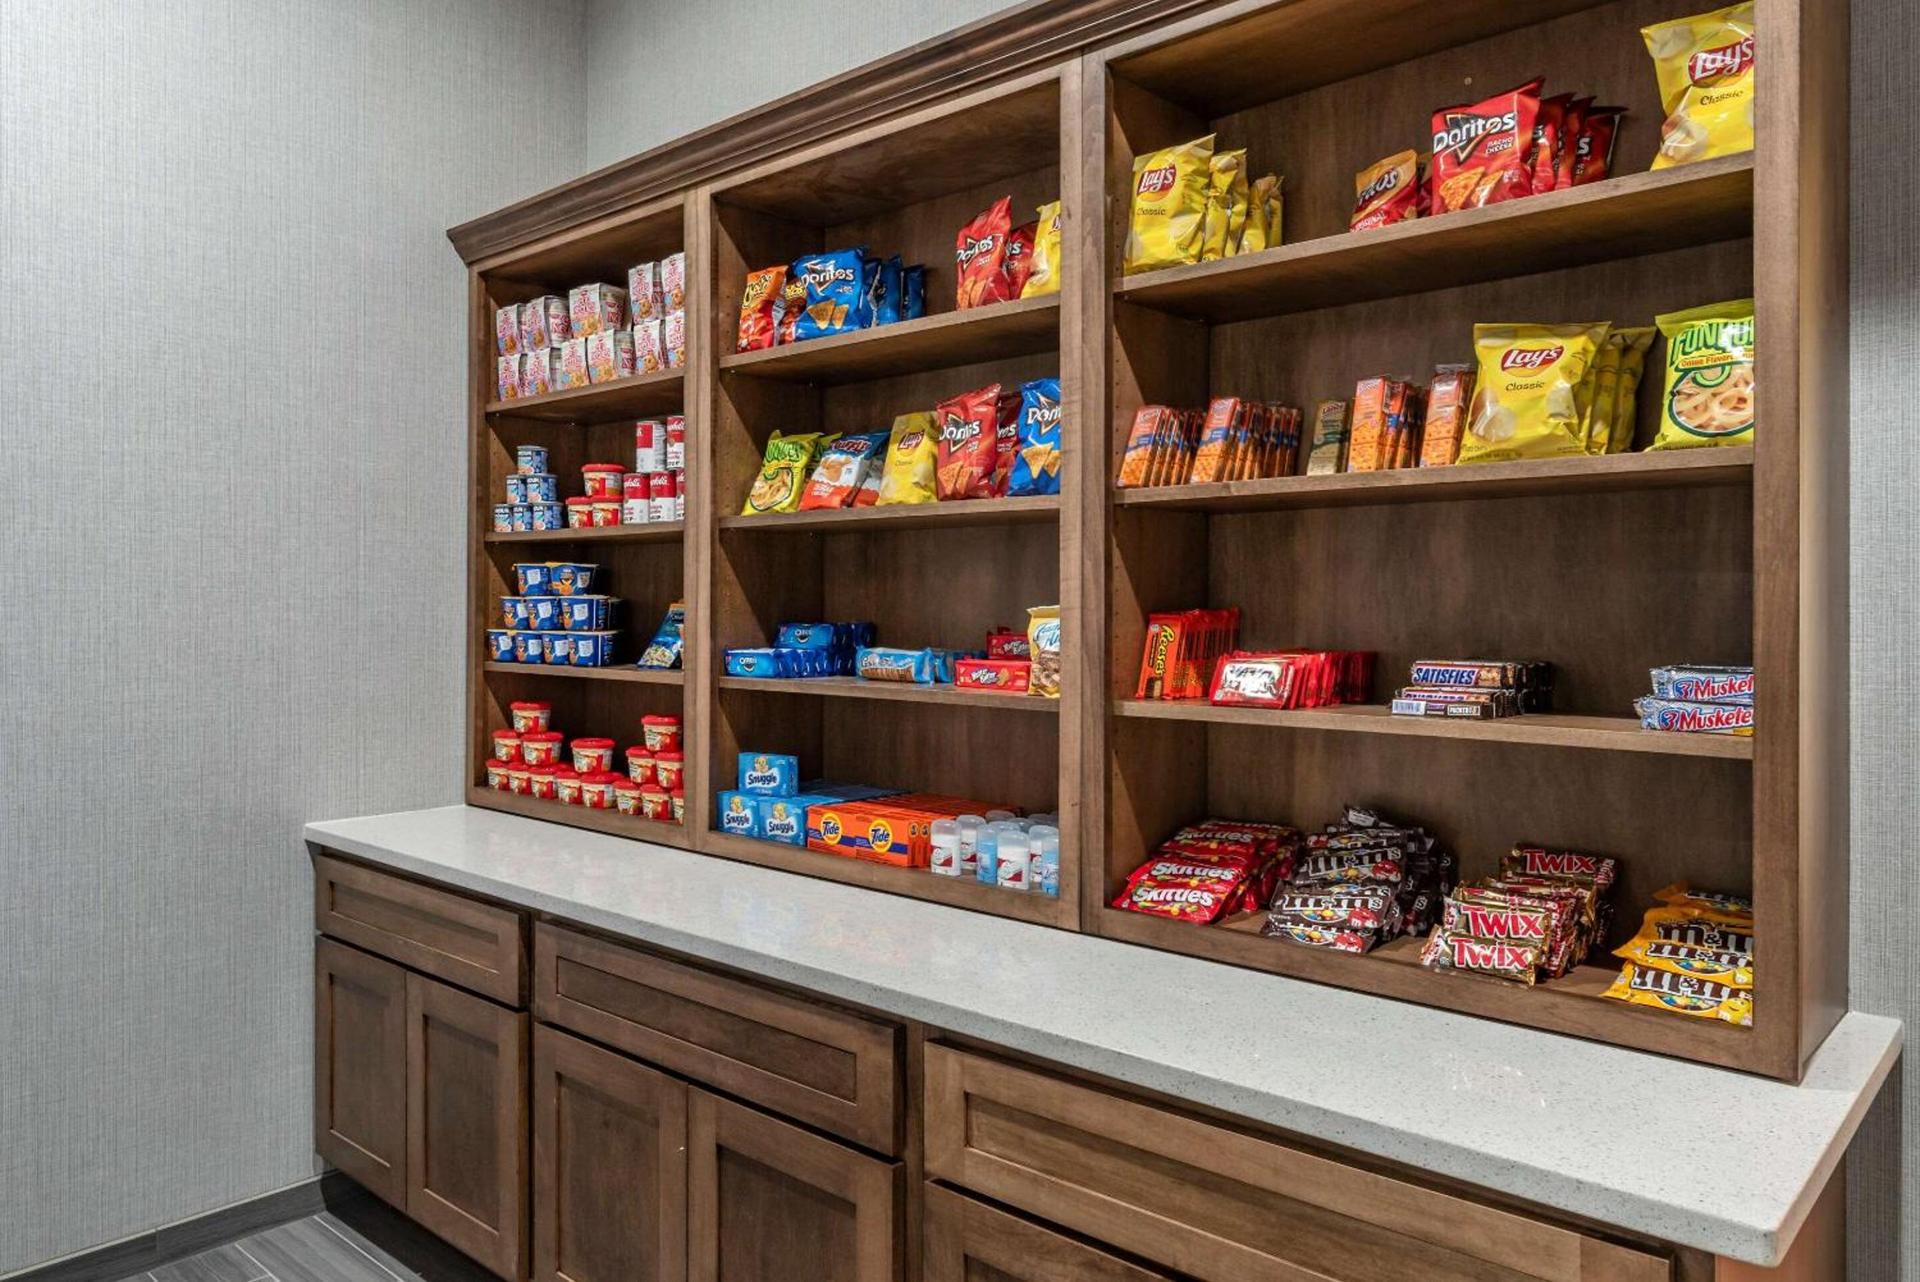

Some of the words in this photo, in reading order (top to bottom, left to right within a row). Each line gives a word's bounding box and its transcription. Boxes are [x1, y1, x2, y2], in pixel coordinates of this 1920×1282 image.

[1700, 90, 1743, 106] Classic
[1432, 111, 1516, 154] Doritos
[1139, 164, 1176, 193] Lay's
[800, 268, 854, 288] Doritos
[1503, 345, 1564, 369] Lay's
[1505, 382, 1546, 393] Classic
[1154, 625, 1175, 677] Reese's
[1414, 667, 1476, 685] SATISFIES
[1694, 675, 1755, 700] Musket
[1680, 706, 1753, 730] Muskete
[748, 772, 778, 785] Snuggle
[725, 813, 750, 826] Snuggle
[768, 820, 795, 834] Snuggle
[822, 821, 840, 836] Tide
[870, 828, 891, 845] Tide
[1151, 862, 1235, 880] Skittles
[1132, 886, 1216, 906] Skittles
